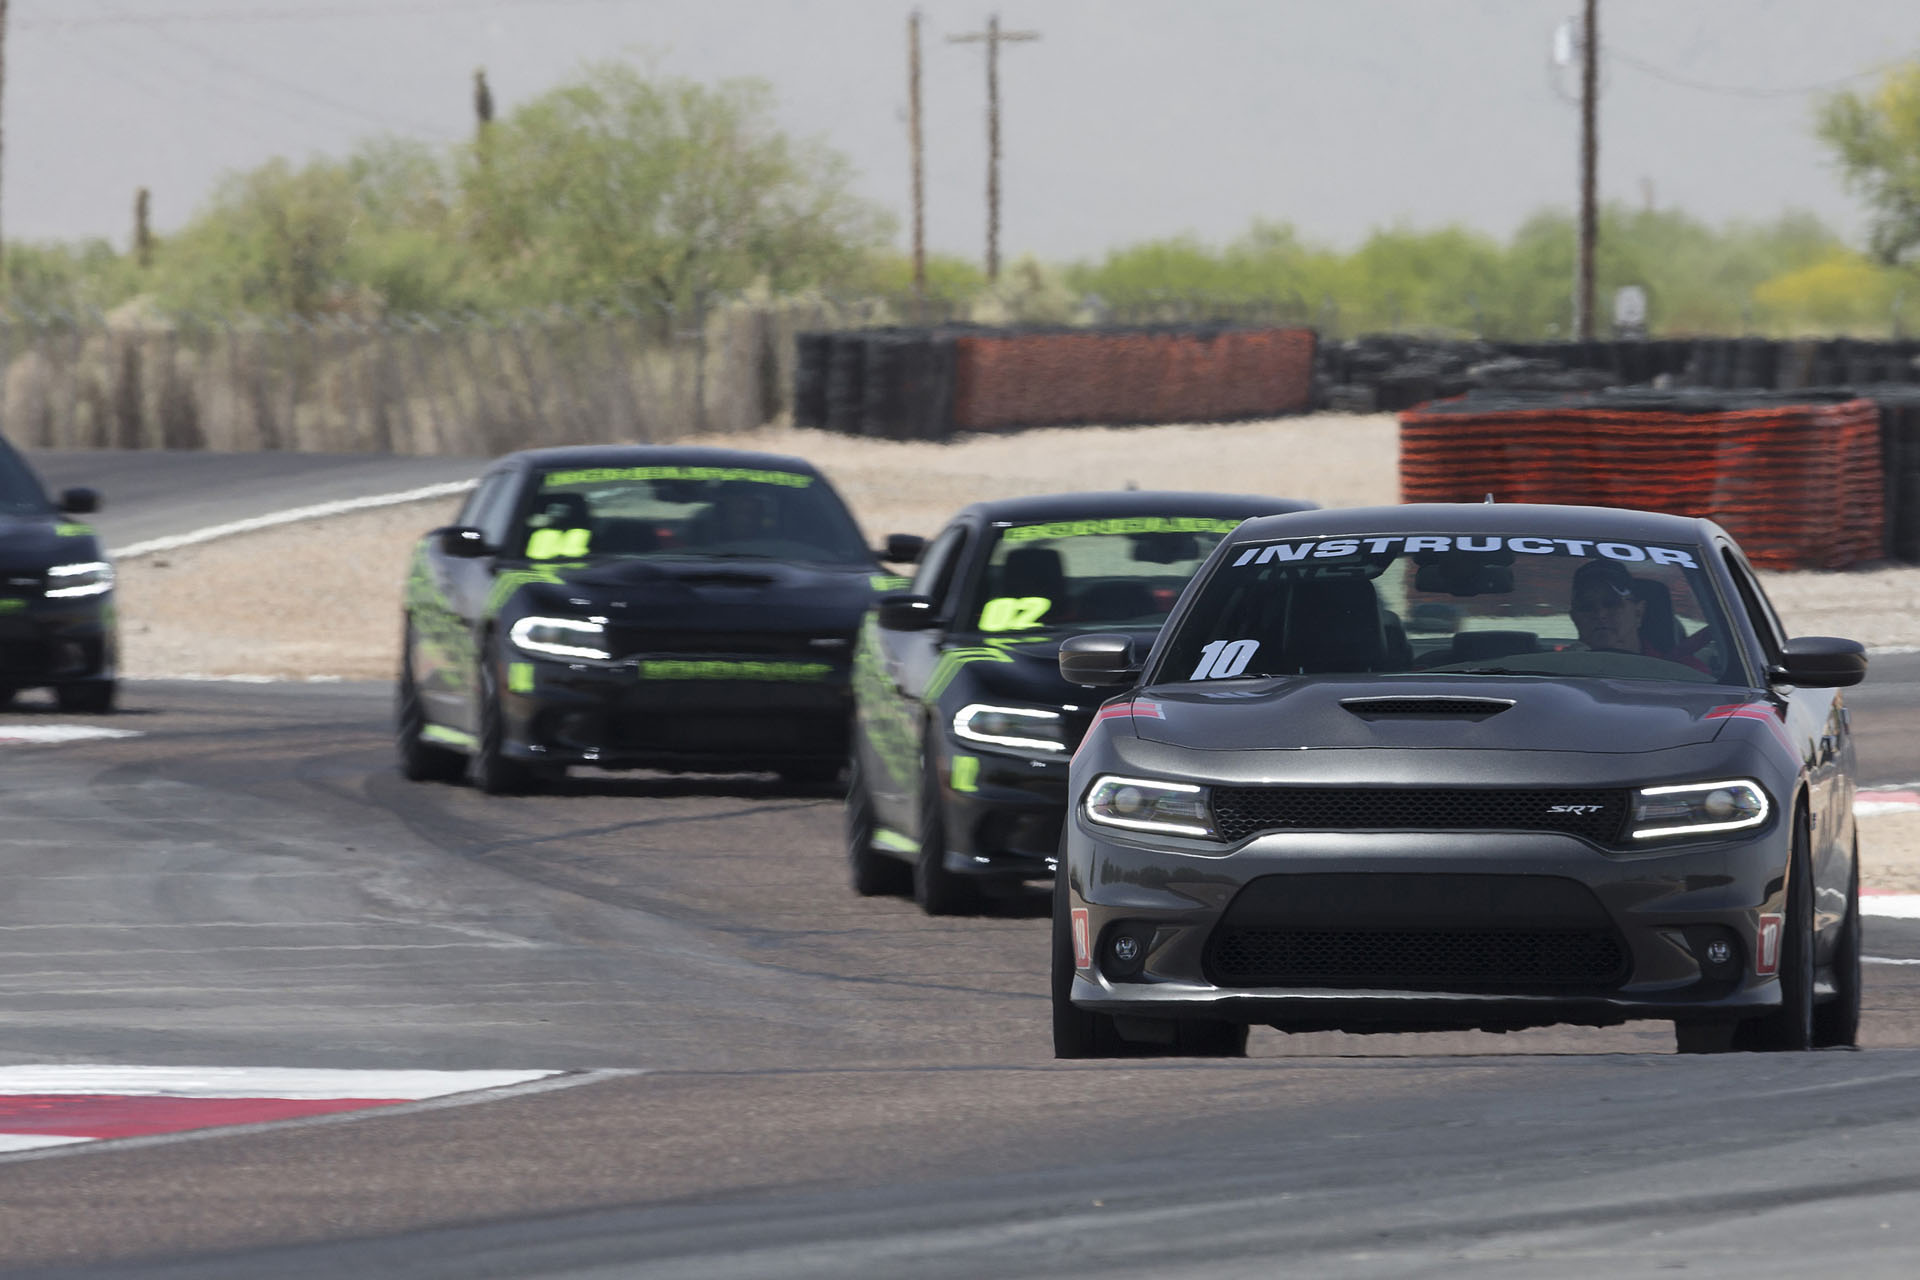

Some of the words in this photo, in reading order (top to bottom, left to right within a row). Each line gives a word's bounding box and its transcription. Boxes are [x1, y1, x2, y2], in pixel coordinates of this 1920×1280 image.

[1233, 536, 1699, 569] INSTRUCTOR
[1189, 639, 1260, 681] 10
[1546, 805, 1605, 816] SRT
